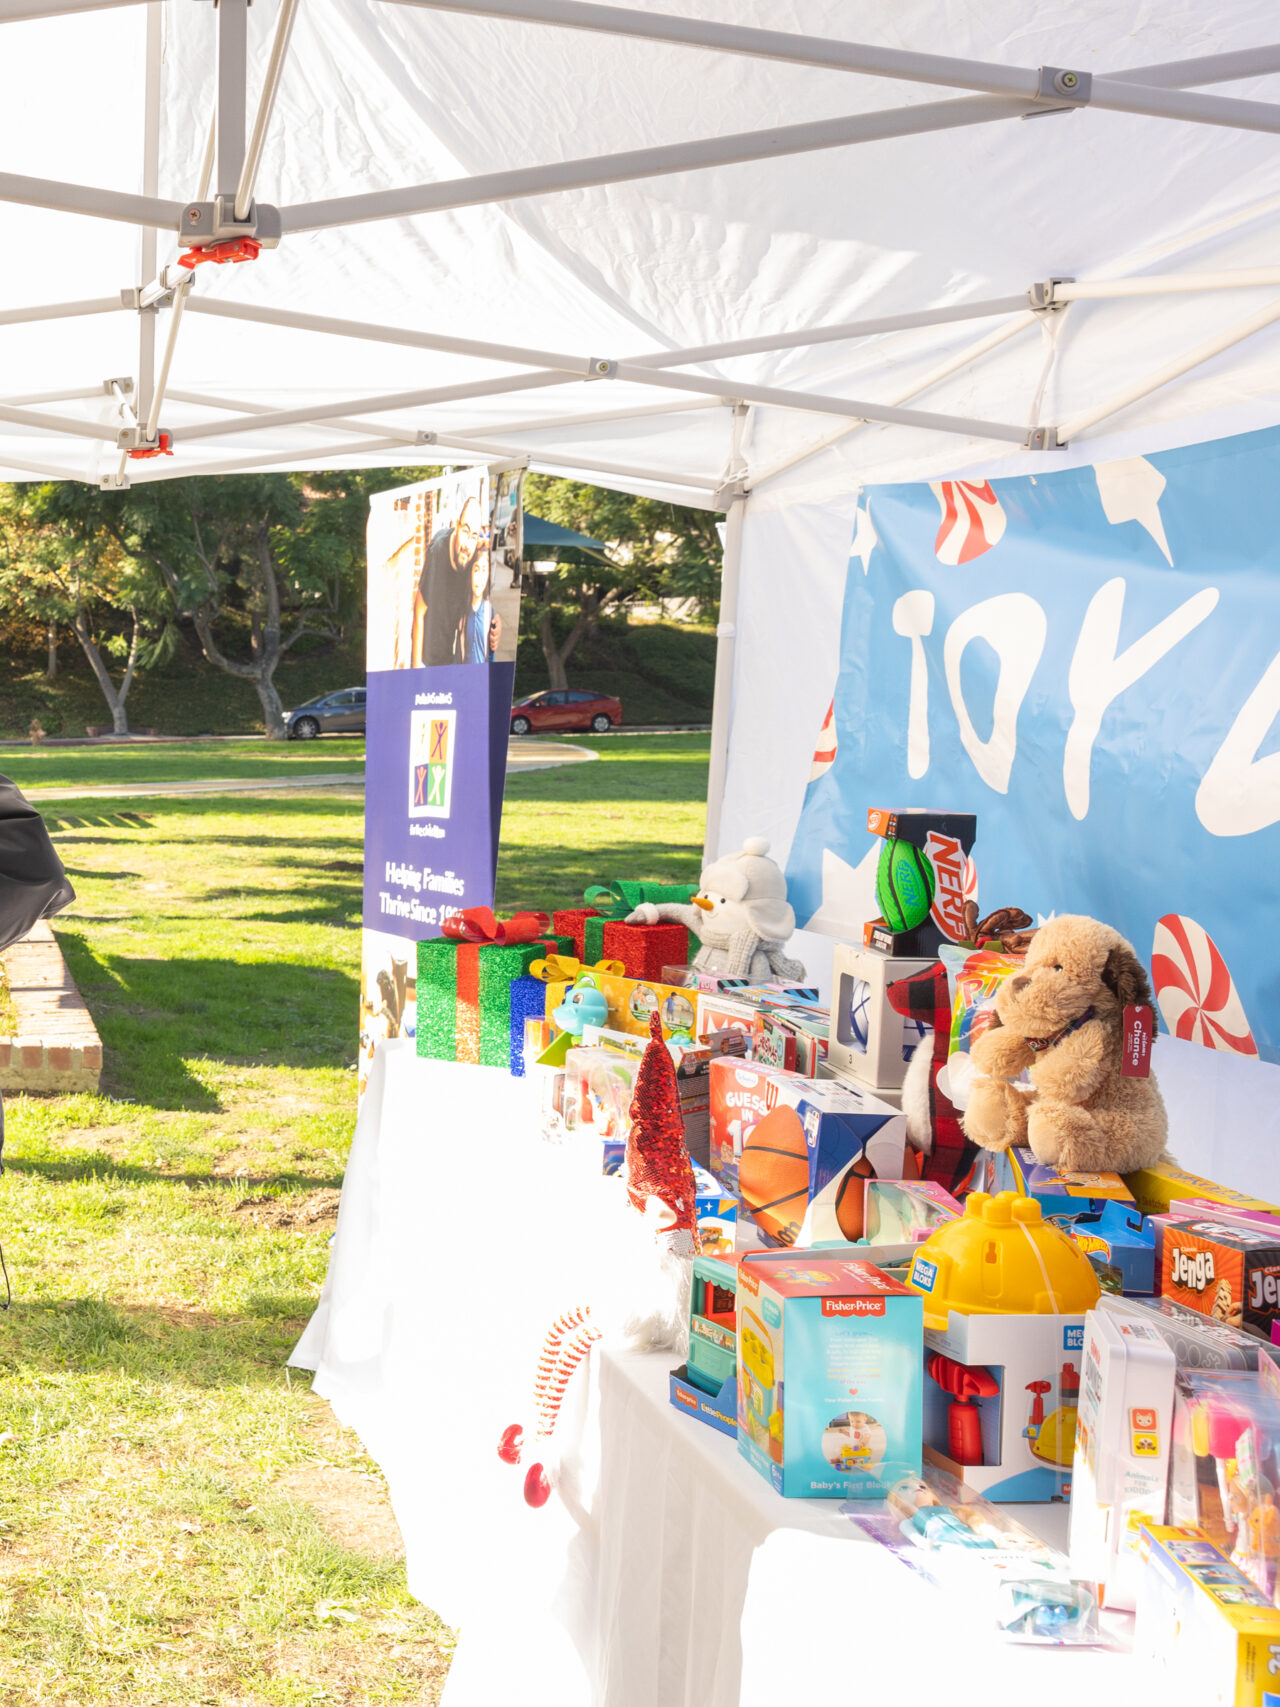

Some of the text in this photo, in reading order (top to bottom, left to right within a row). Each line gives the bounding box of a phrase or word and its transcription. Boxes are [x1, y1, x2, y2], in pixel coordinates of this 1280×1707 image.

[385, 861, 465, 897] Helping Families
[897, 860, 921, 908] NERF
[928, 832, 967, 938] NERF
[379, 892, 410, 919] Thrive
[410, 898, 437, 925] Since
[1132, 1020, 1143, 1067] Chance
[725, 1092, 771, 1117] GUESS
[741, 1108, 754, 1122] IN
[914, 1271, 933, 1288] BLOKS
[915, 1261, 934, 1278] MEGA
[1171, 1248, 1215, 1291] Jenga
[826, 1301, 882, 1311] Fisher-Price
[810, 1481, 841, 1490] Baby's
[843, 1481, 863, 1489] First
